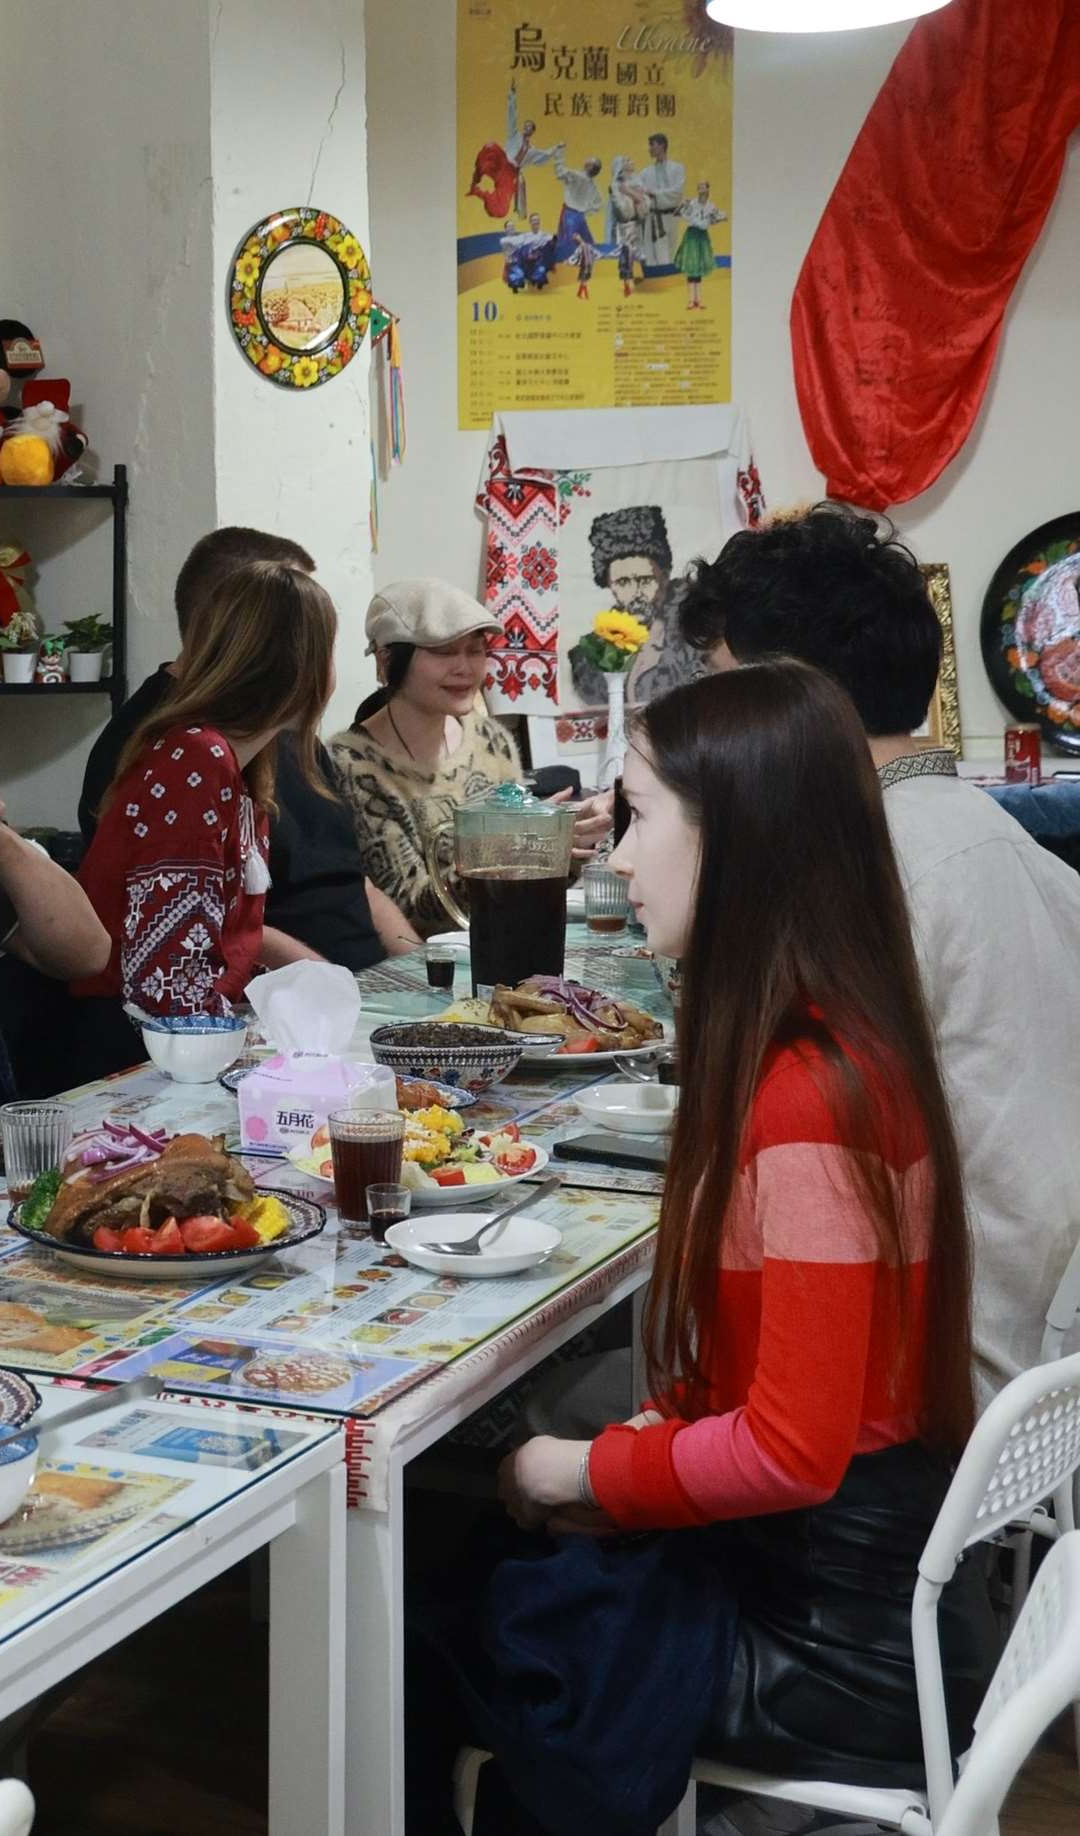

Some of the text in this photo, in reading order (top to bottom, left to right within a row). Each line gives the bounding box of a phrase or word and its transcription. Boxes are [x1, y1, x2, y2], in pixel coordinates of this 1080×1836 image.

[616, 24, 712, 51] Ukraine
[544, 92, 676, 118] 民族舞蹈團
[472, 301, 498, 322] 10
[276, 1110, 316, 1129] 五月花
